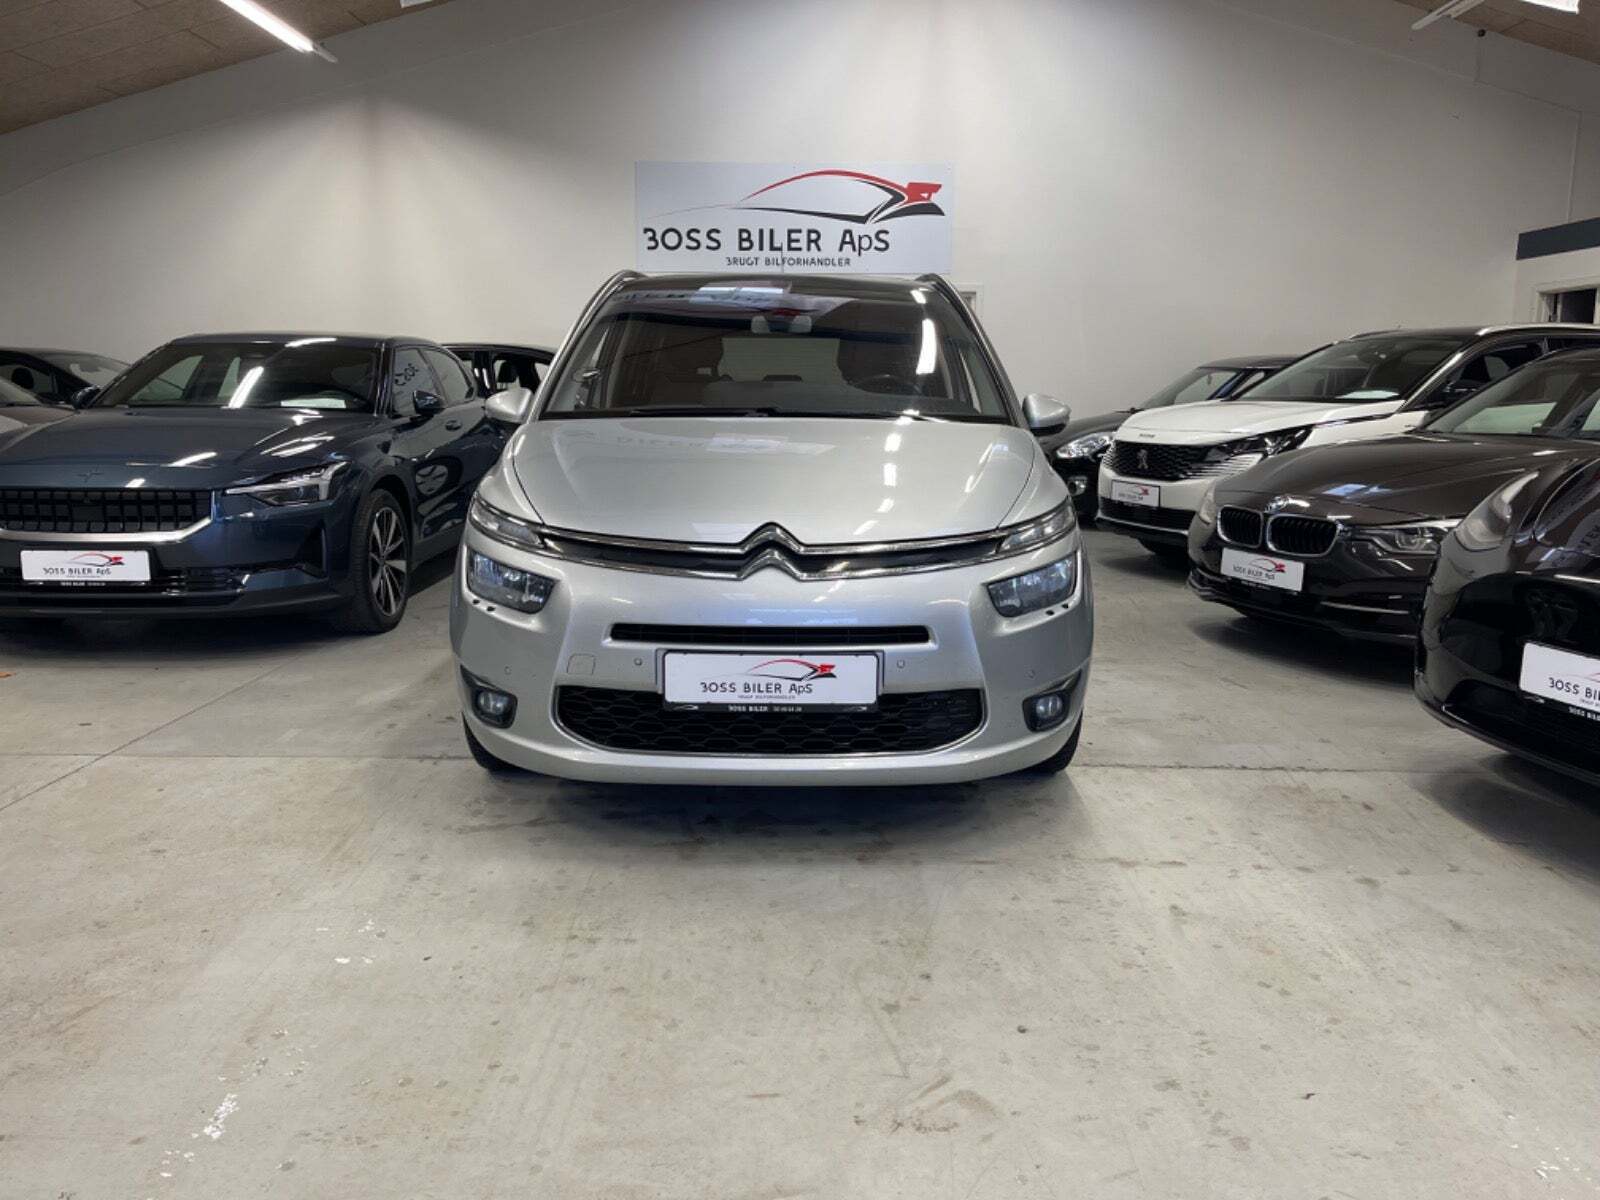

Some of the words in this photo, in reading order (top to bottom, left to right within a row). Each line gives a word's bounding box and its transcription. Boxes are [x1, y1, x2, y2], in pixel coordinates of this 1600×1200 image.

[737, 228, 822, 252] BILER
[838, 228, 890, 257] ApS
[764, 256, 851, 268] BILFORHANDLER
[743, 682, 782, 693] BILER
[788, 683, 813, 695] ApS
